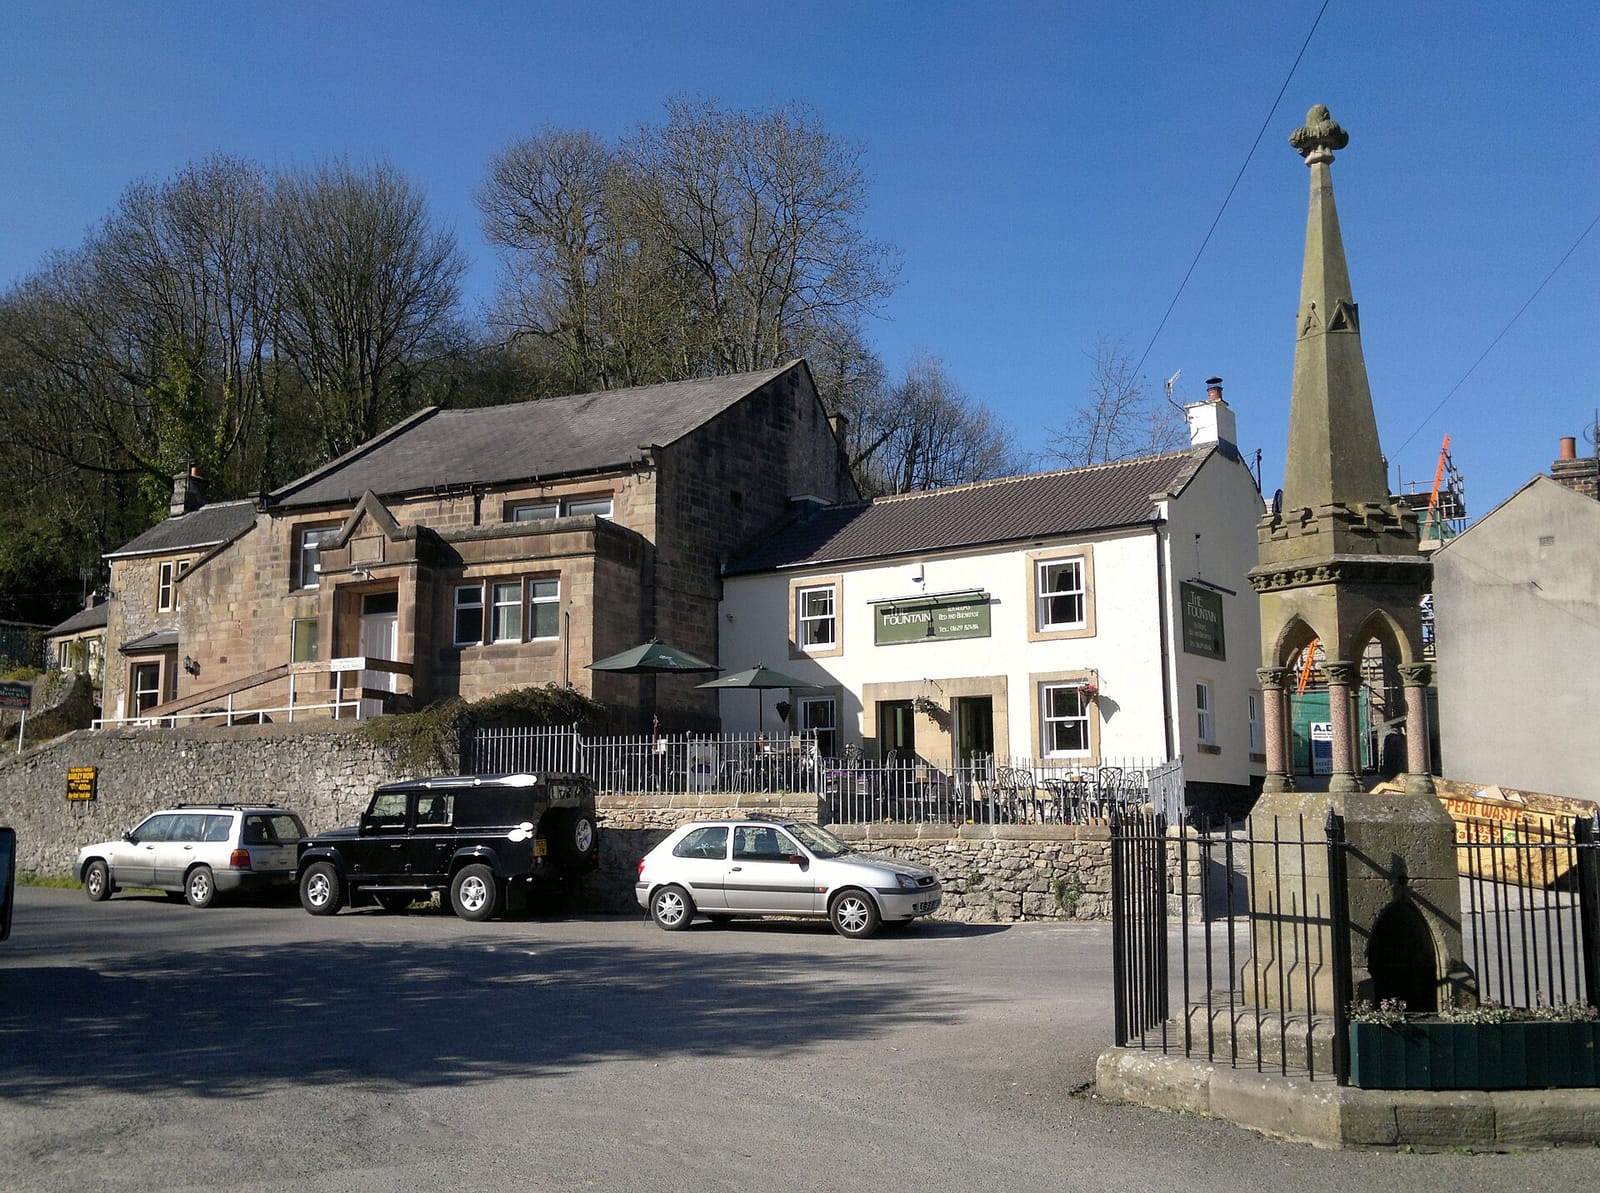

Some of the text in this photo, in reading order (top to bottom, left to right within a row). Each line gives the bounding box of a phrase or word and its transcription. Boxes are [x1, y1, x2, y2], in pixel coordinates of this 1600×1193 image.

[883, 613, 931, 626] FOUNTAIN
[1446, 799, 1523, 823] PEAK WASTE
